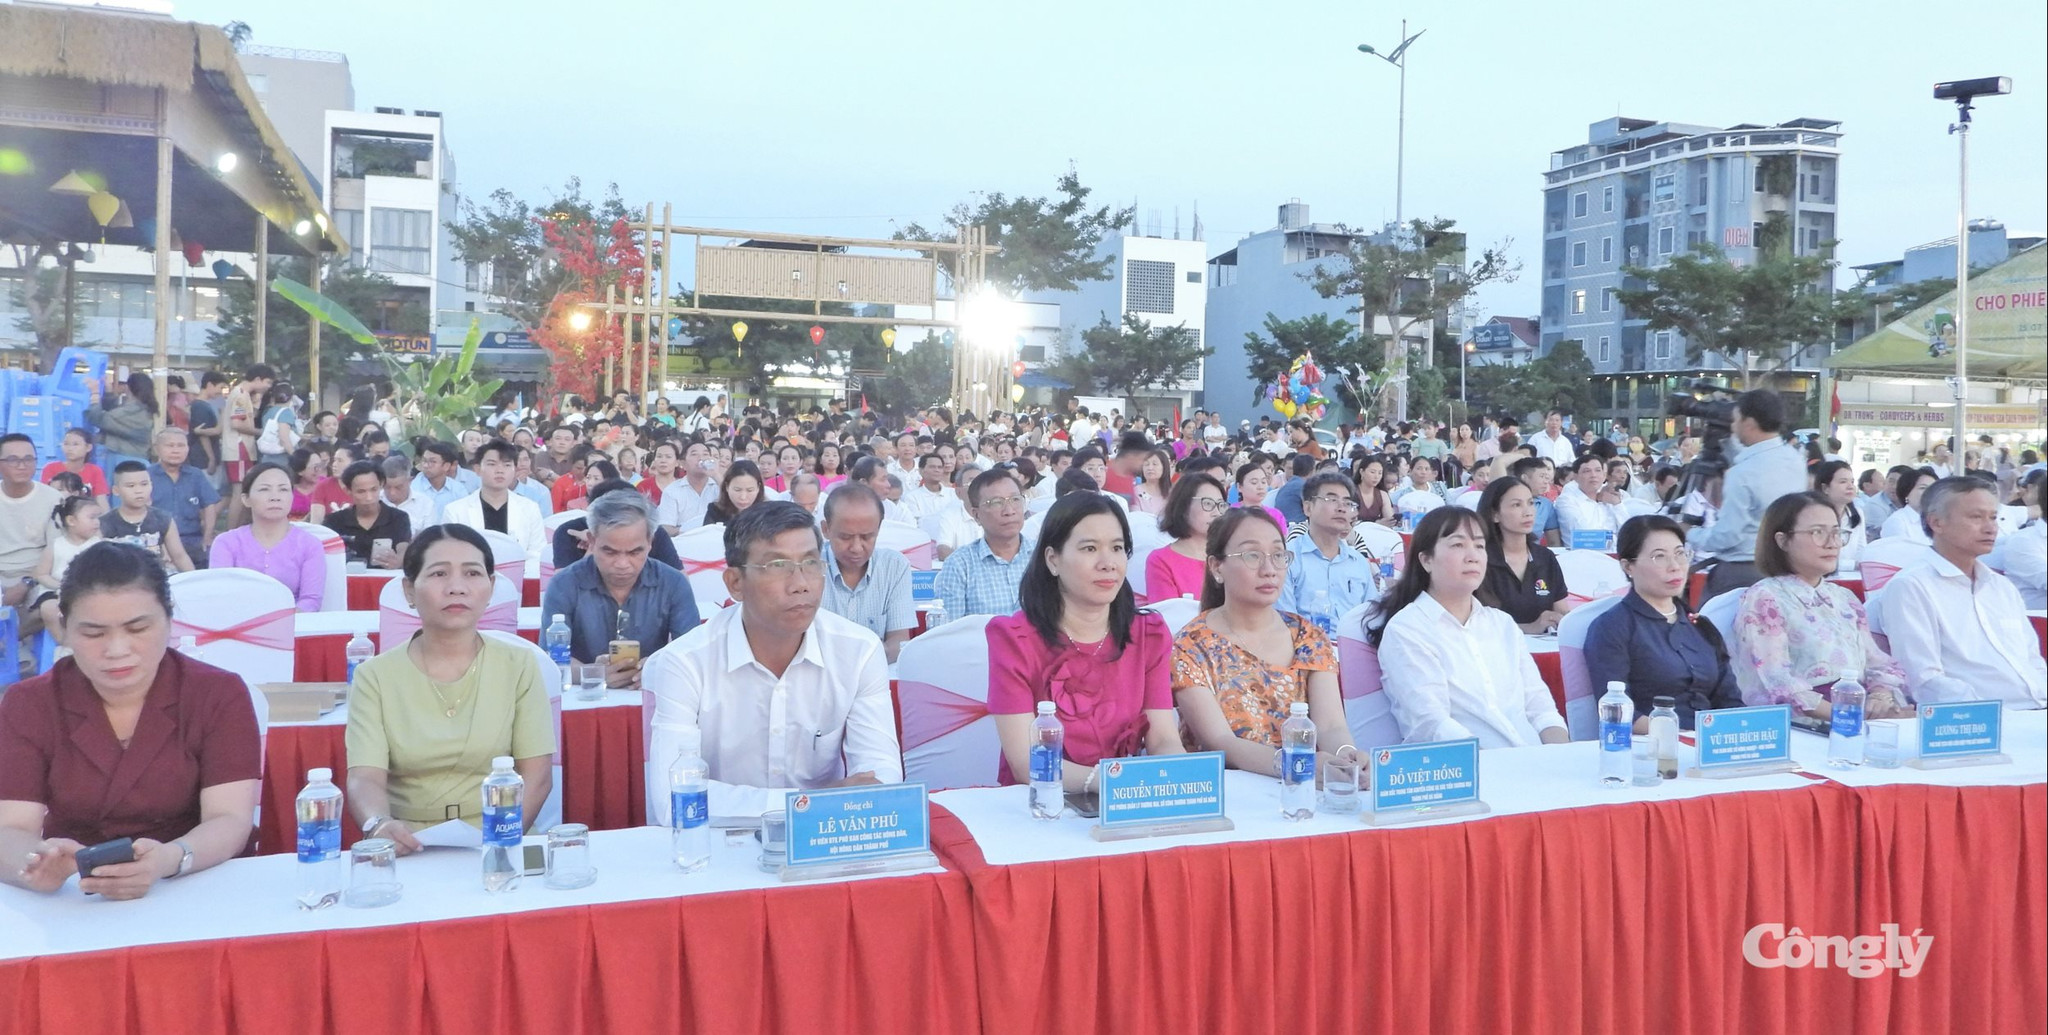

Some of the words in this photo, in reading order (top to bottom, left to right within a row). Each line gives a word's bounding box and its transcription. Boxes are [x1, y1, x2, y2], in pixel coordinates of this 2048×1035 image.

[1723, 732, 1738, 747] THỊ
[1739, 729, 1760, 743] BÍCH
[1761, 727, 1779, 743] HẬU
[1407, 767, 1431, 785] VIỆT
[1113, 780, 1152, 800] NGUYỄN
[1180, 780, 1213, 795] NHUNG
[818, 816, 836, 834] LÊ
[838, 815, 867, 832] VĂN
[870, 810, 899, 829] PHÚ
